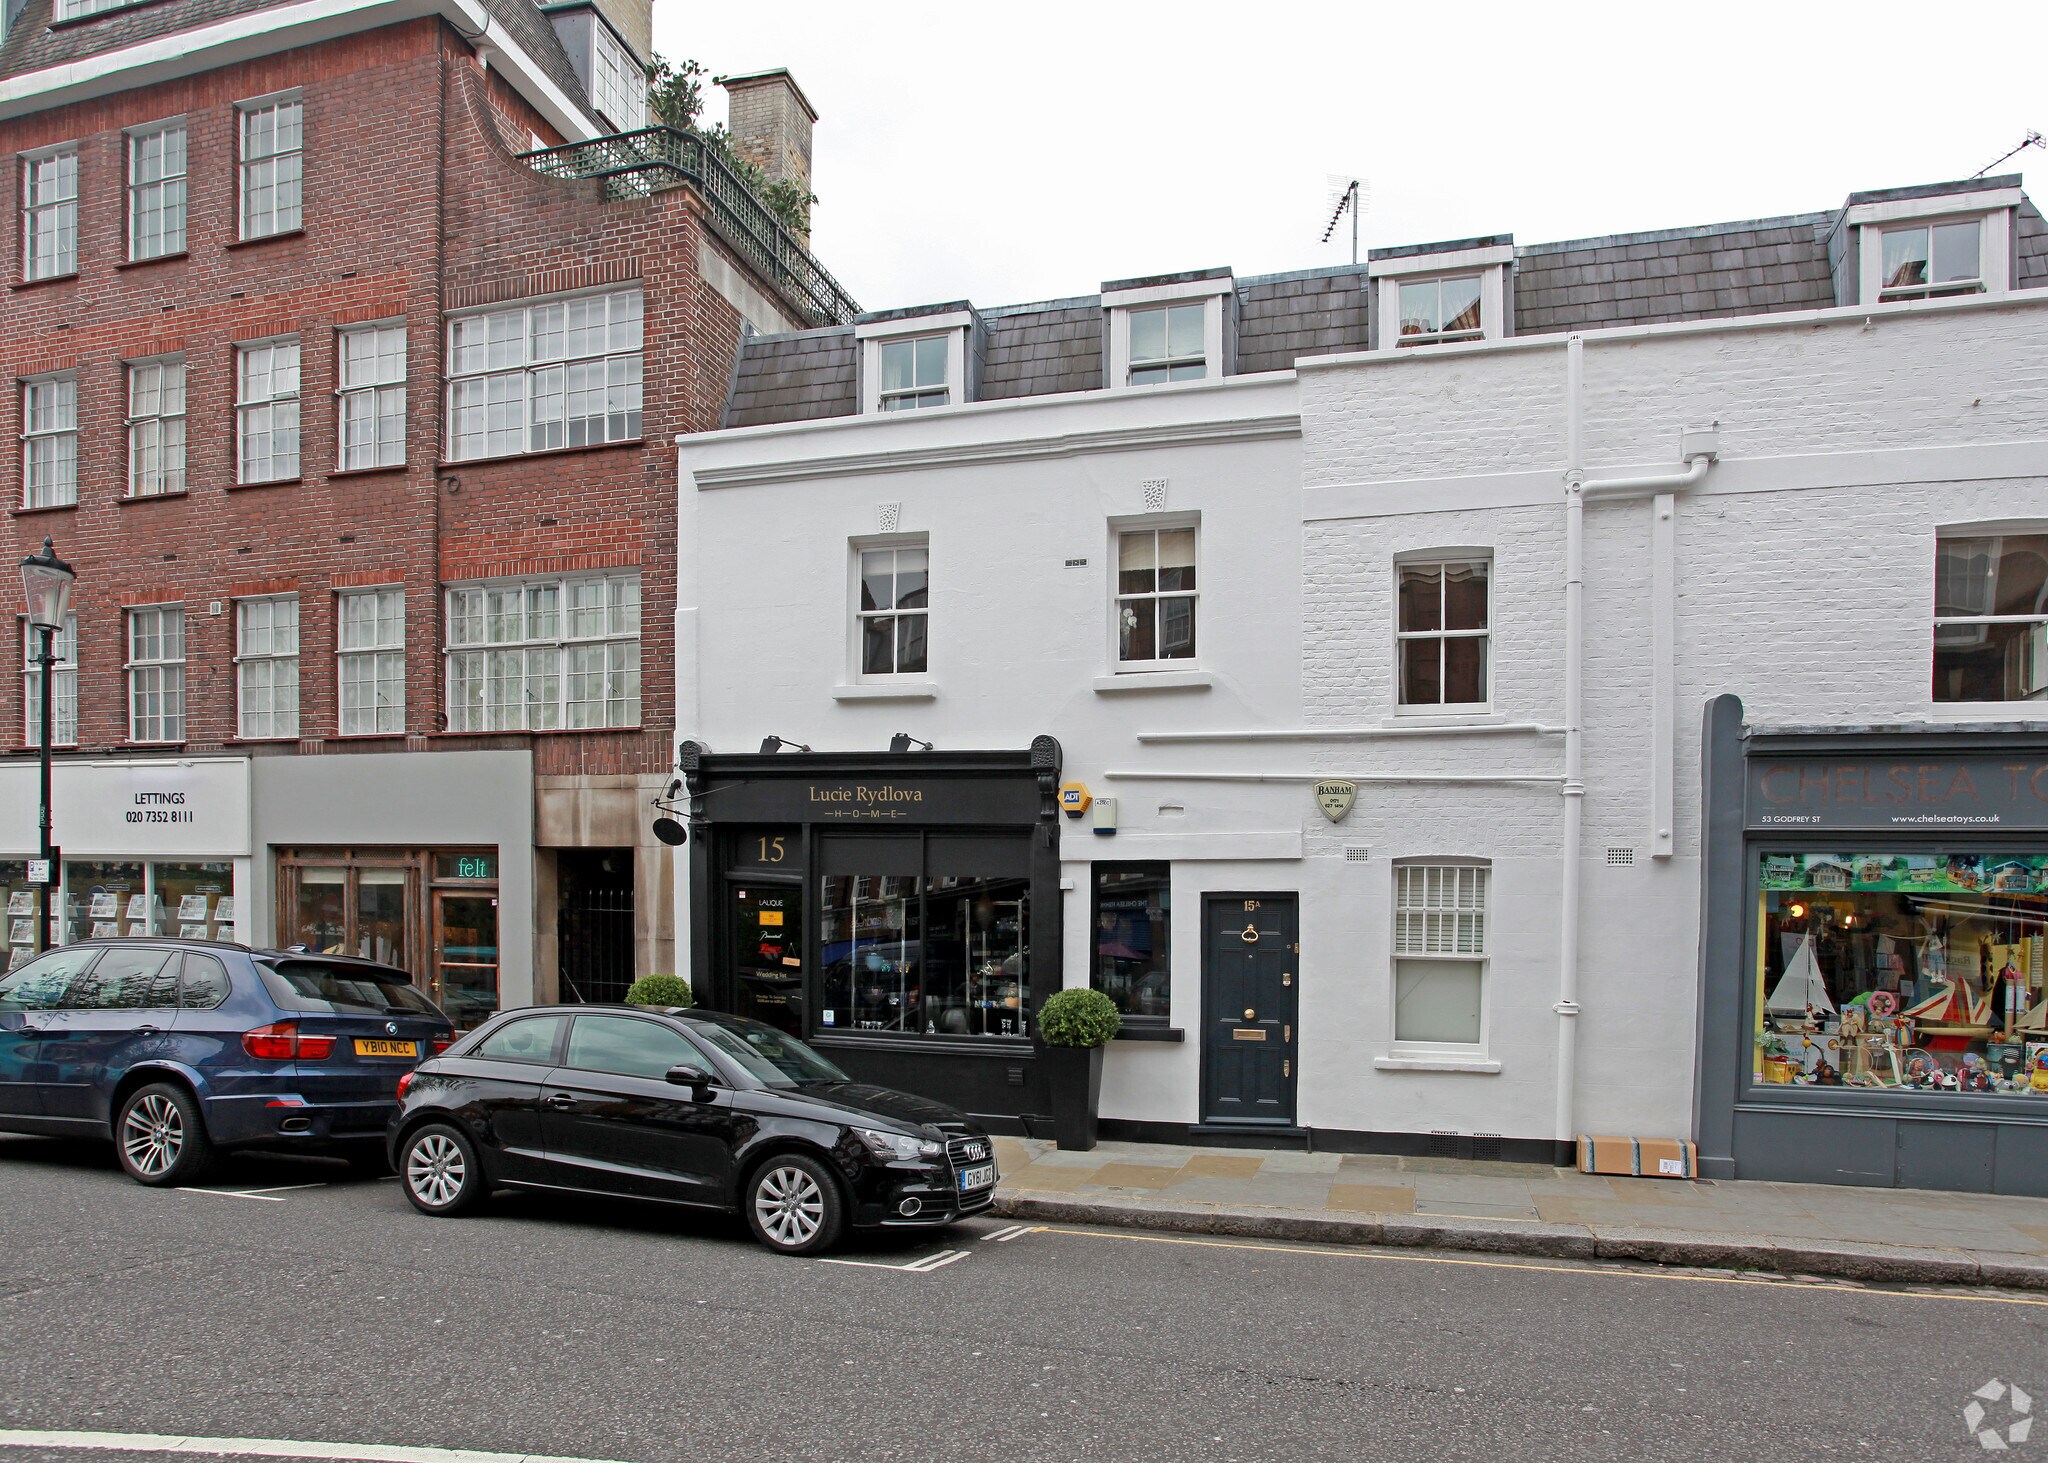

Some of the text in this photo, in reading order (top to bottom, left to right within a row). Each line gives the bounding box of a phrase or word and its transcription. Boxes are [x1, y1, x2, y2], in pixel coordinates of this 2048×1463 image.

[1761, 764, 1979, 803] CHELSEA
[809, 786, 922, 805] Lucie Rydlova
[1064, 792, 1079, 801] ADT
[1318, 786, 1352, 795] BANHAM
[135, 792, 185, 805] LETTINGS
[126, 811, 193, 823] 020 7352 8111
[1761, 815, 1821, 823] 53 GODFREY ST
[1891, 814, 2000, 824] www.chelseatoys.co.uk
[757, 836, 785, 863] 15
[458, 857, 487, 878] felt
[1244, 900, 1261, 912] 15A
[756, 970, 779, 979] Wedding
[363, 1041, 410, 1054] YB10 NCC
